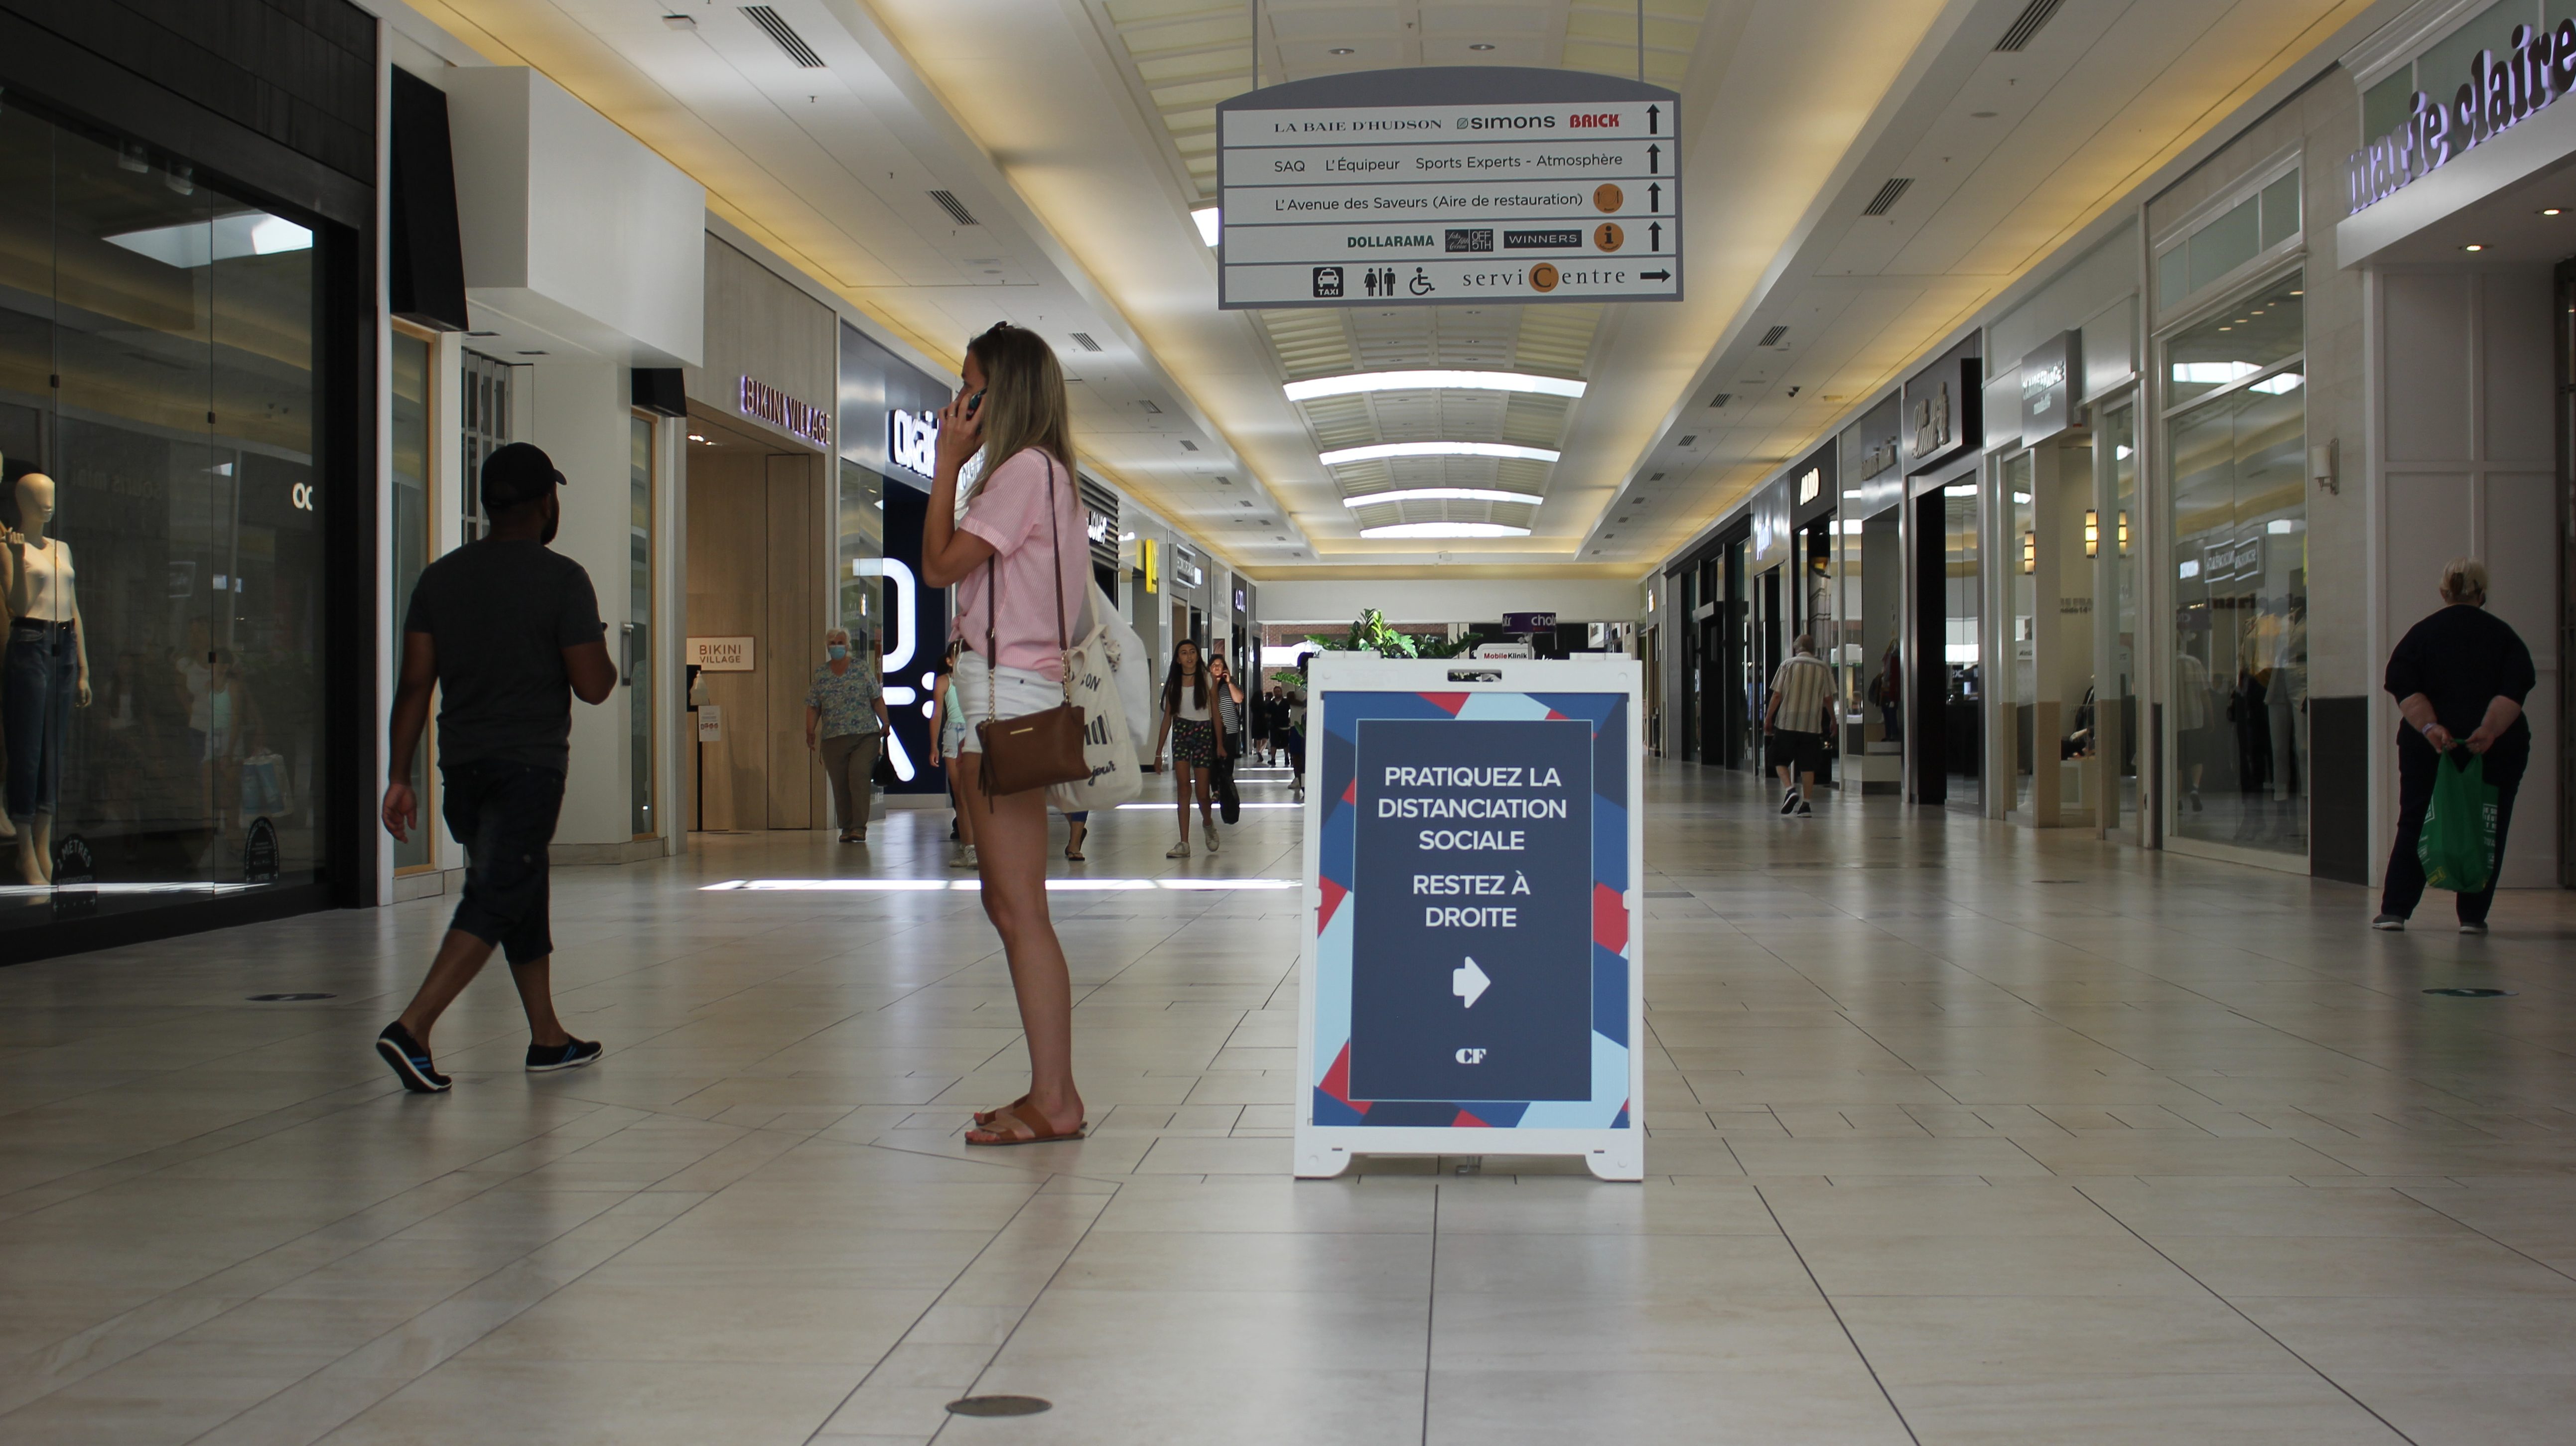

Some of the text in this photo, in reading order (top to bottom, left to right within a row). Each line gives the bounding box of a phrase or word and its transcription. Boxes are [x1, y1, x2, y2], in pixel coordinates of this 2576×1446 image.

[1471, 115, 1556, 130] simons
[1570, 114, 1618, 128] BRICK
[2343, 18, 2576, 215] marie claire
[1275, 120, 1442, 132] LA BAIE D'HUDSON
[1274, 160, 1305, 173] SAQ
[1326, 156, 1400, 173] L'Équipeur
[1416, 157, 1462, 171] Sports
[1468, 156, 1521, 170] Experts
[1536, 153, 1623, 168] Atmosphère
[1344, 197, 1368, 209] des
[1374, 197, 1428, 209] Saveurs
[1433, 195, 1467, 209] (Aire
[1472, 195, 1489, 207] de
[1494, 193, 1583, 207] restauration)
[1347, 235, 1435, 248] DOLLARAMA
[1472, 231, 1491, 240] OFF
[1508, 234, 1577, 244] WINNERS
[1472, 240, 1491, 250] 5TH
[744, 375, 831, 445] BIKINI VILLAGE
[1799, 467, 1820, 506] ALDO
[699, 645, 741, 655] BIKINI
[1385, 767, 1562, 787] PRATIQUEZ LA
[1378, 798, 1567, 818] DISTANCIATION
[1419, 830, 1524, 850] SOCIALE
[1413, 870, 1531, 895] RESTEZ À
[1425, 907, 1517, 927] DROITE
[1455, 1048, 1487, 1064] CF
